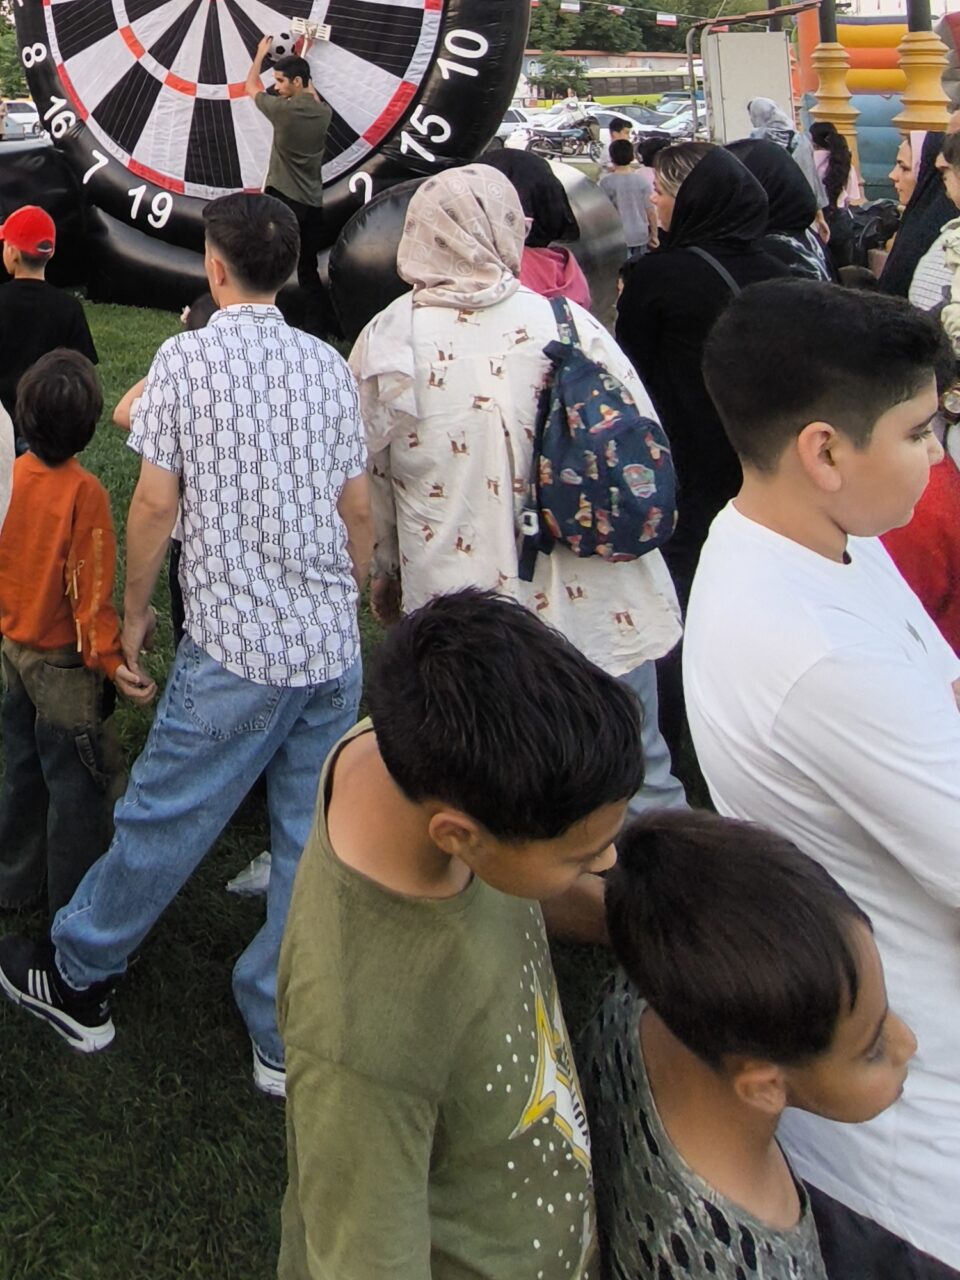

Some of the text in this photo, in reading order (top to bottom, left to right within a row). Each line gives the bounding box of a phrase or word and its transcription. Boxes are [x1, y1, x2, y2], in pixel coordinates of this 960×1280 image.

[21, 42, 48, 69] 8
[436, 29, 489, 81] 10
[43, 95, 76, 139] 16
[400, 103, 452, 162] 15
[82, 149, 109, 184] 7
[127, 185, 173, 229] 19
